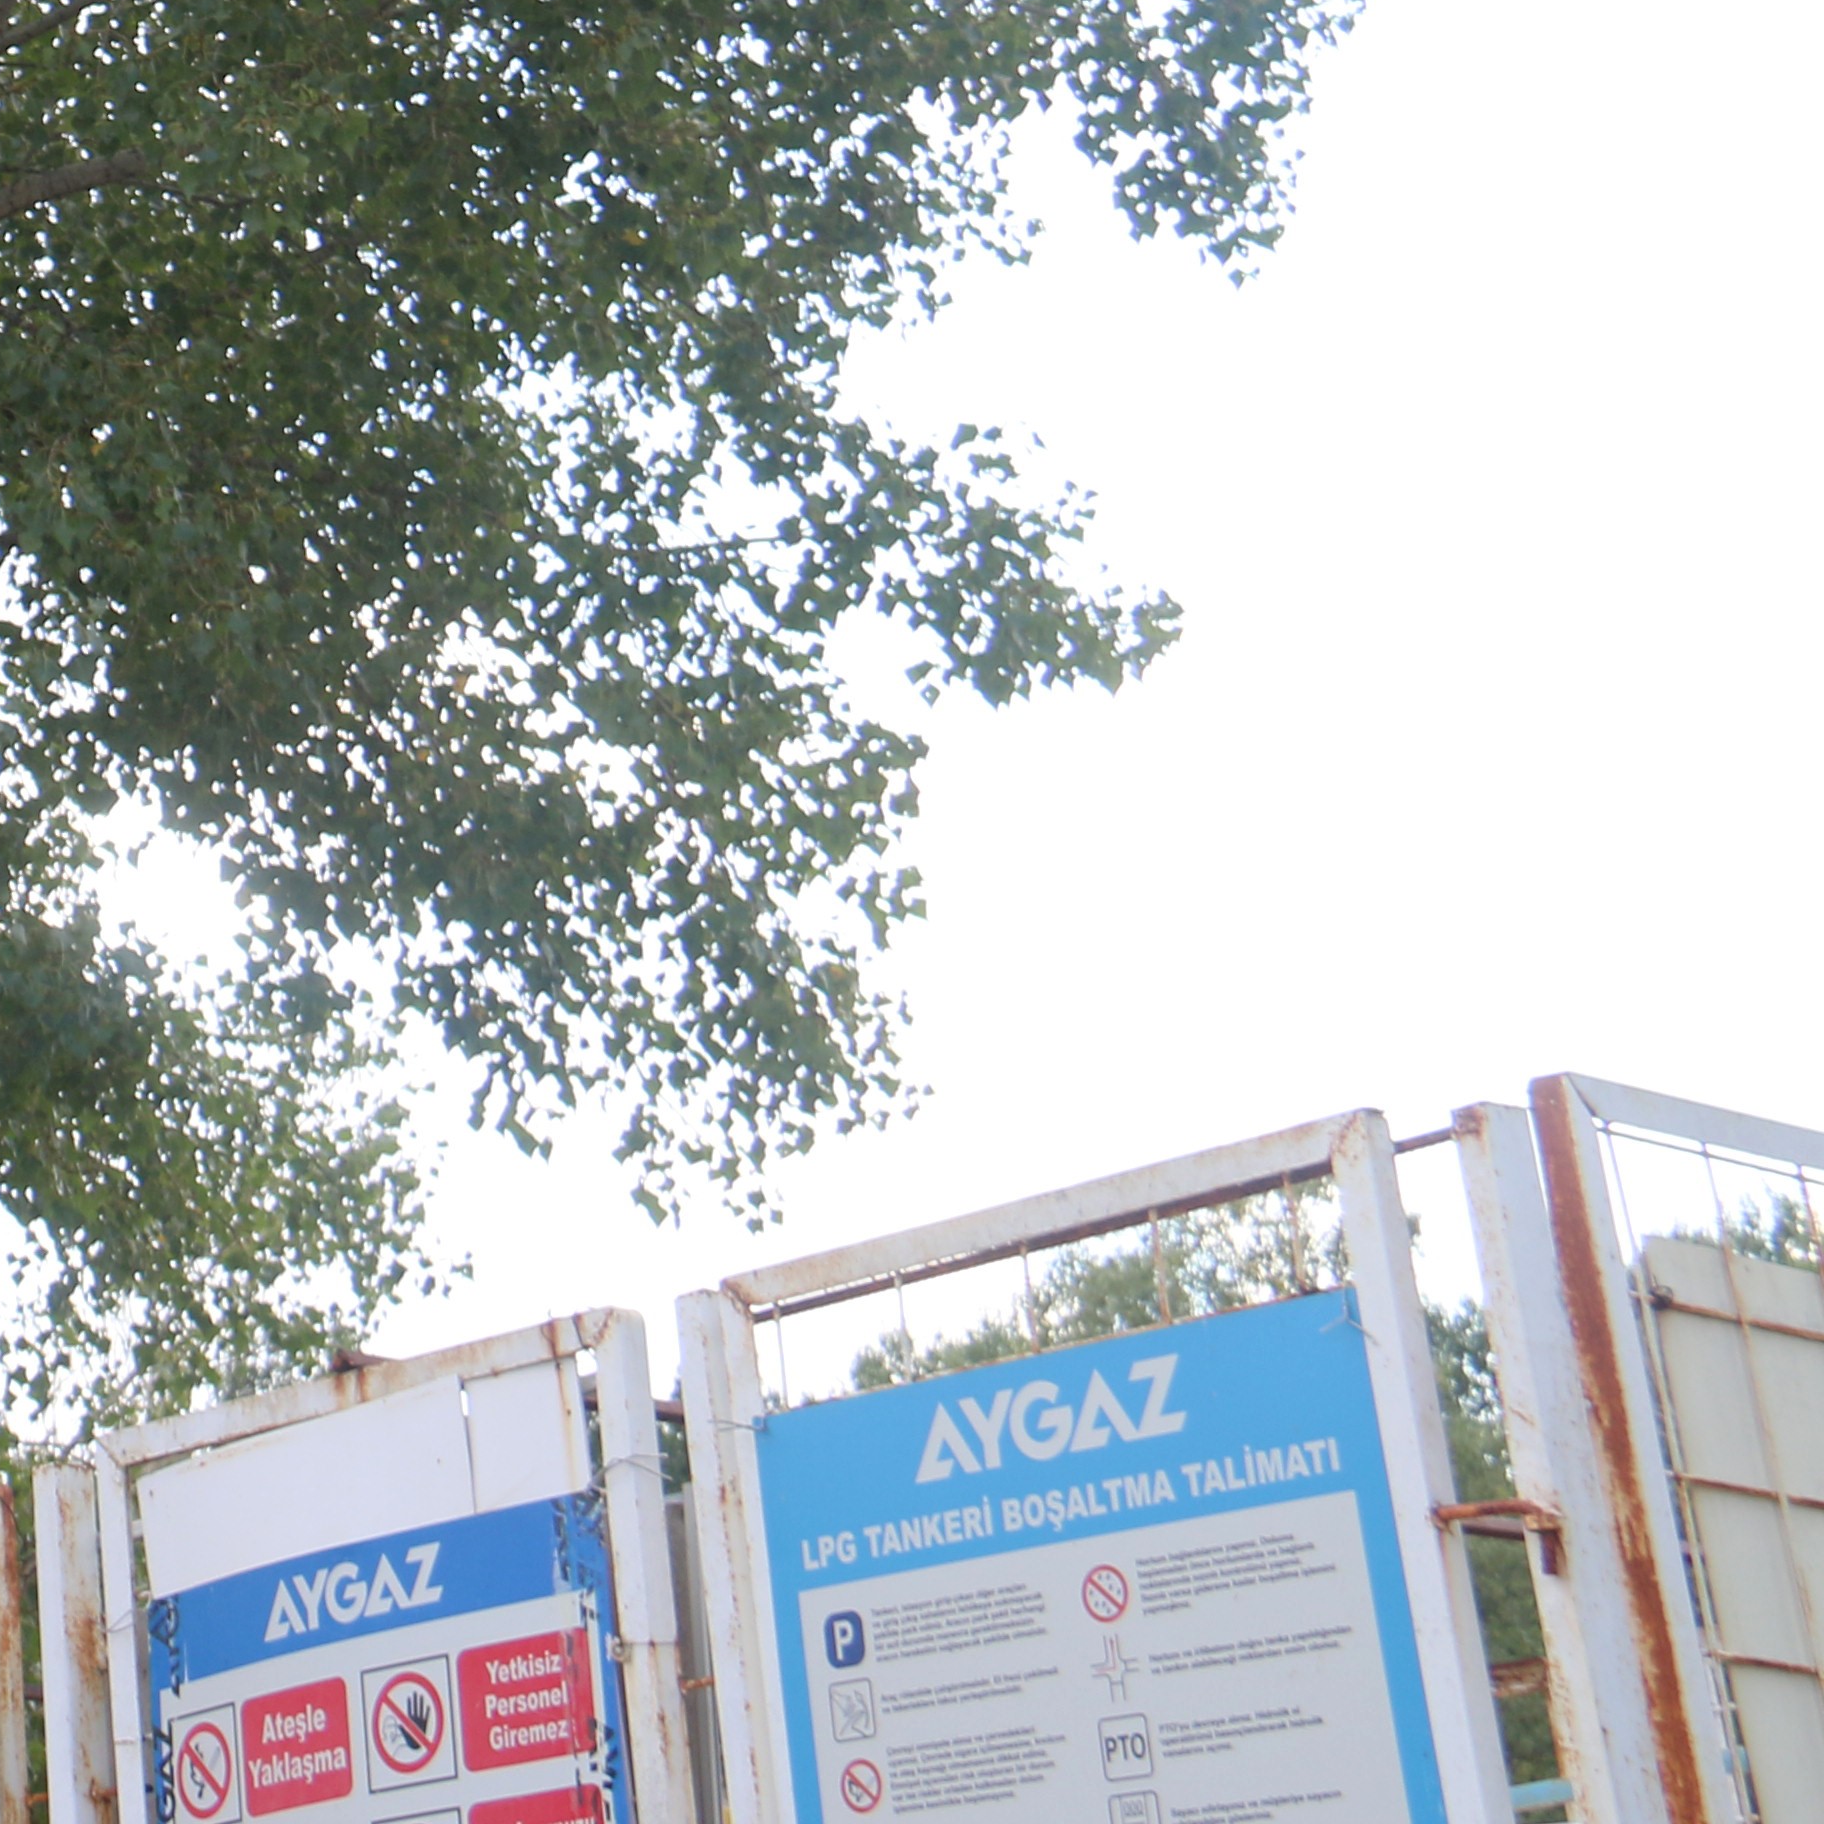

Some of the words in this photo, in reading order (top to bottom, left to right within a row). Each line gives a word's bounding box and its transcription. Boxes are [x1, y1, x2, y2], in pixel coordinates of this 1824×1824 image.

[916, 1353, 1187, 1484] AYGAZ
[801, 1531, 857, 1571] LPG
[864, 1497, 994, 1558] TANKERİ
[1002, 1468, 1176, 1532] BOŞALTMA
[1181, 1437, 1341, 1497] TALİMATI
[264, 1541, 444, 1643] AYGAZ
[484, 1650, 563, 1685] Yetkisiz
[484, 1680, 569, 1718] Personel
[262, 1703, 327, 1744] Ateşle
[489, 1720, 569, 1751] Giremez
[248, 1746, 347, 1789] Yaklaşma
[1104, 1732, 1147, 1763] PTO
